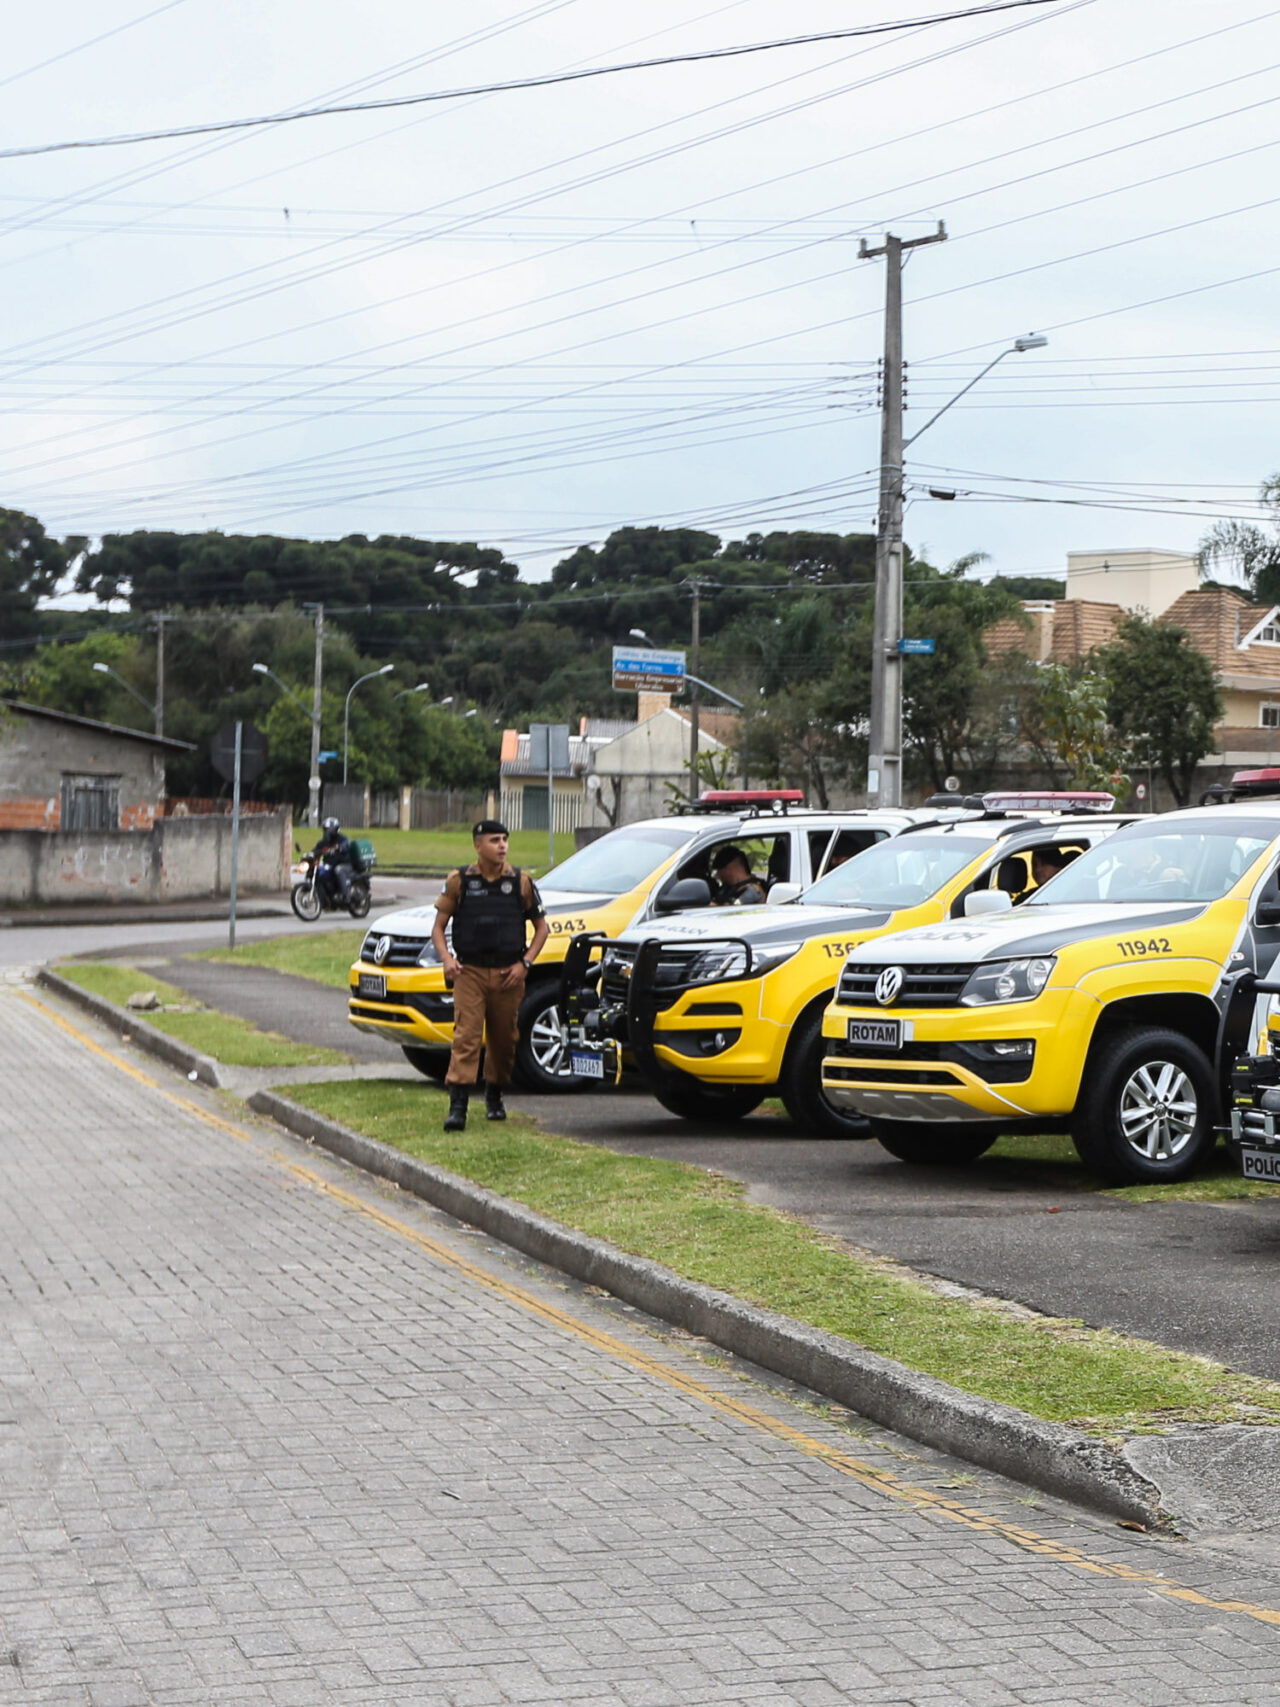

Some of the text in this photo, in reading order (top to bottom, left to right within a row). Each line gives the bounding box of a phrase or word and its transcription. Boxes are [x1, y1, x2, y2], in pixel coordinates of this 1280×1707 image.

[822, 941, 865, 958] 136
[1117, 938, 1172, 956] 11942
[851, 1025, 896, 1042] ROTAM
